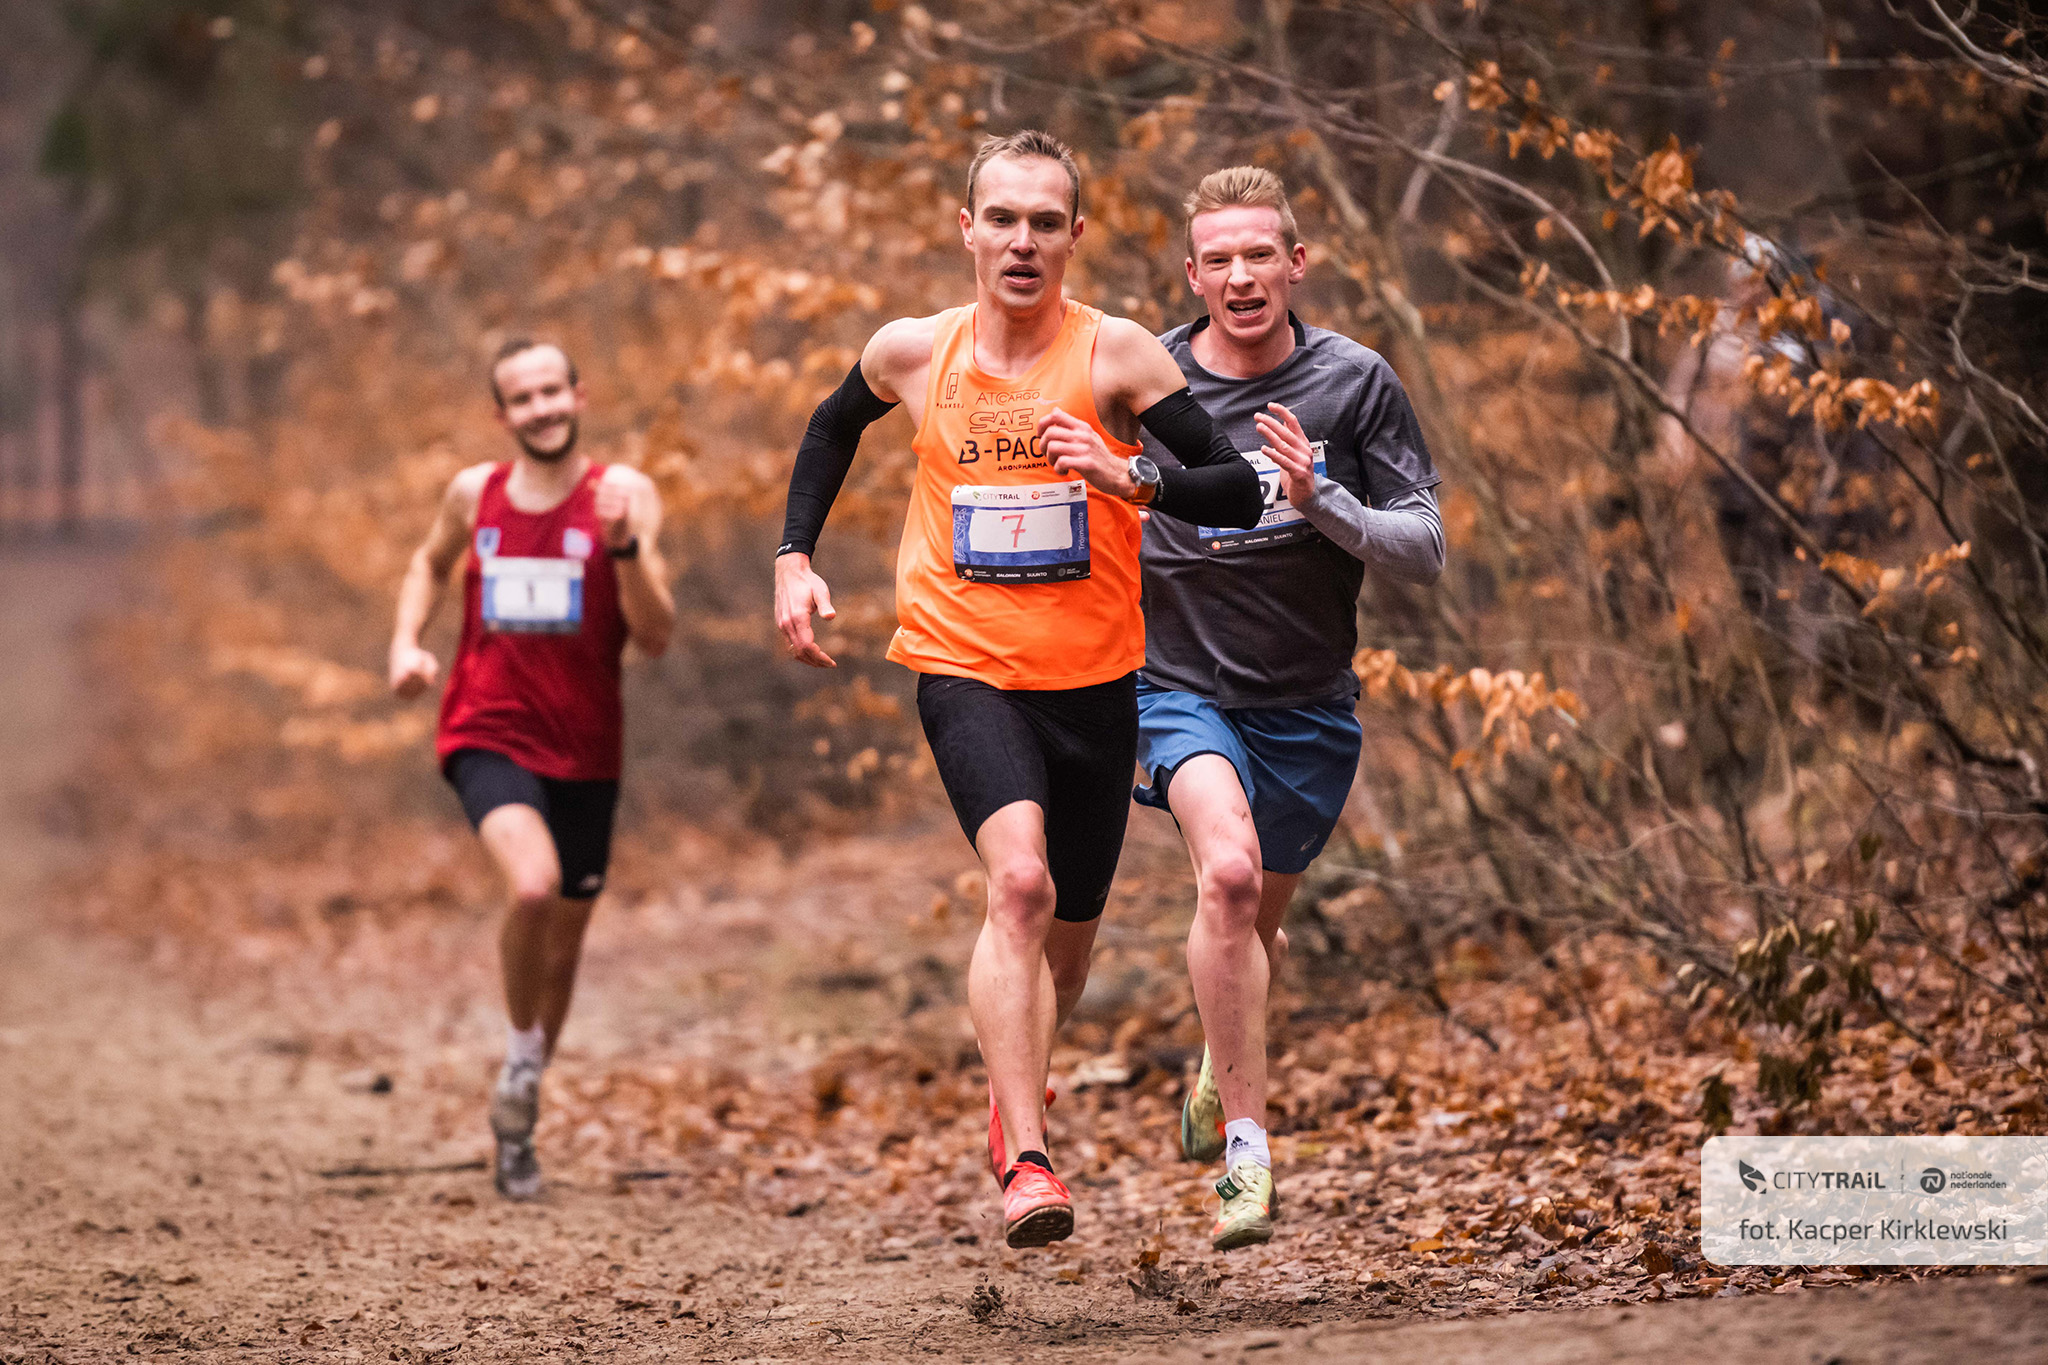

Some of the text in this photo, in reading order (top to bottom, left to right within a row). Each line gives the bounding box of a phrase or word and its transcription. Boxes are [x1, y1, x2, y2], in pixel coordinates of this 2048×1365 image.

[969, 407, 1035, 434] SAE
[958, 435, 1045, 464] B-PAC
[1001, 514, 1026, 548] 7
